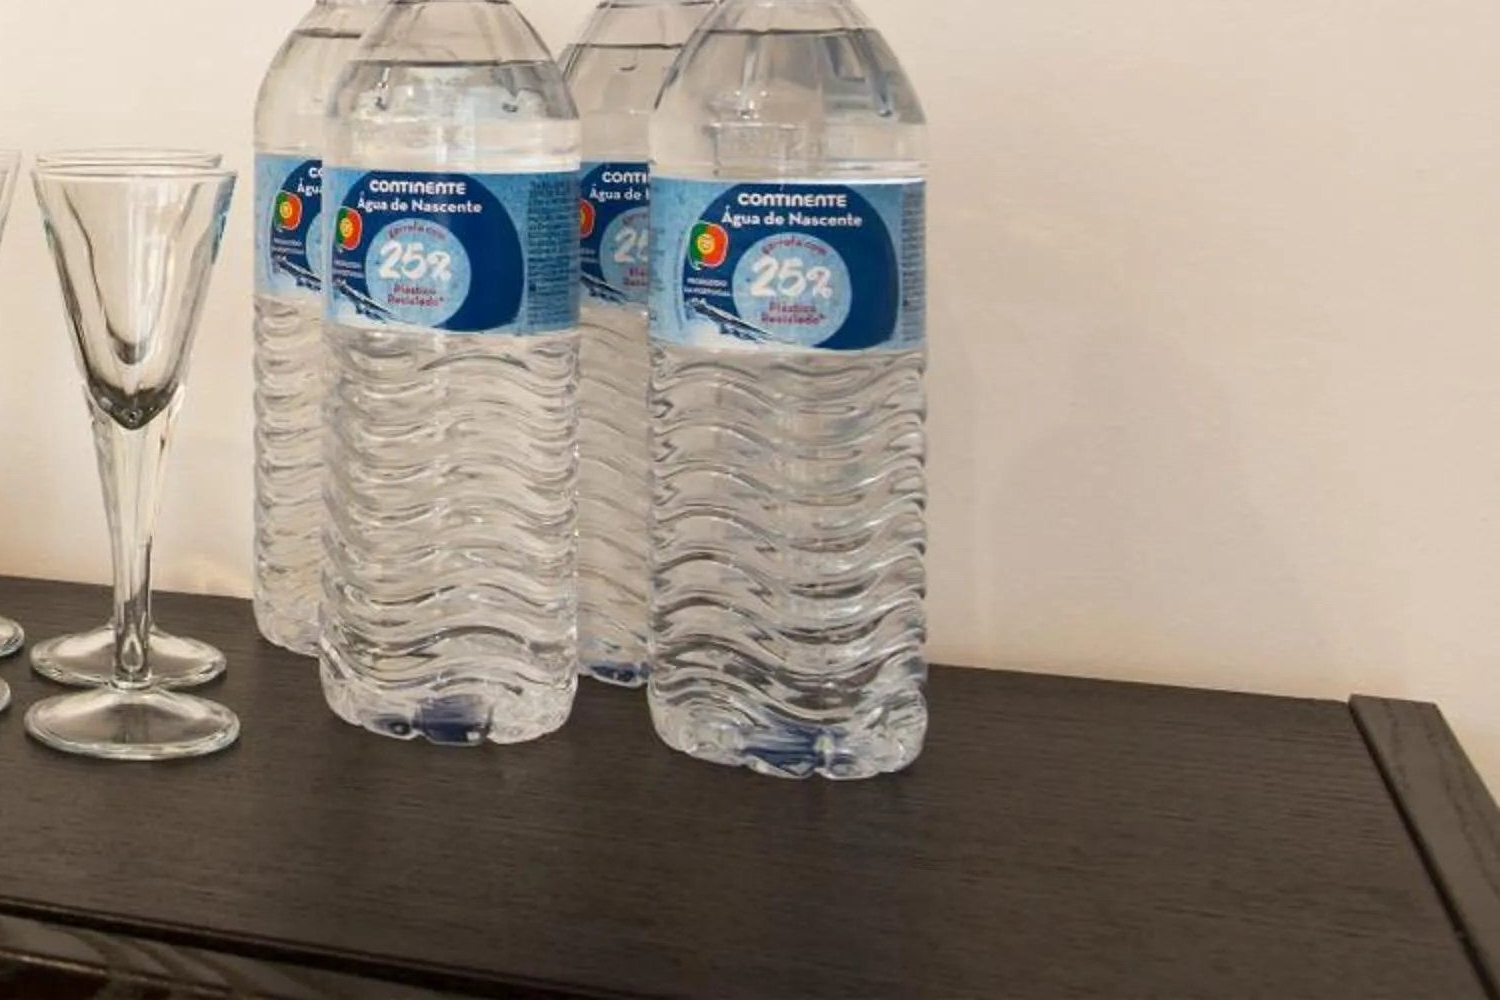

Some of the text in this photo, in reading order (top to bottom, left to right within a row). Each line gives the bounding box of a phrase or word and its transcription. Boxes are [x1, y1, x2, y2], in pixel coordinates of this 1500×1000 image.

[369, 178, 467, 196] CONTINENTE
[601, 171, 648, 184] CONTI
[357, 191, 483, 214] Água de Nascente
[589, 184, 621, 202] Água
[623, 188, 642, 200] de
[737, 192, 848, 208] CONTINENTE
[721, 205, 863, 229] Água de Nascente
[379, 240, 452, 281] 25%
[750, 254, 834, 300] 25%
